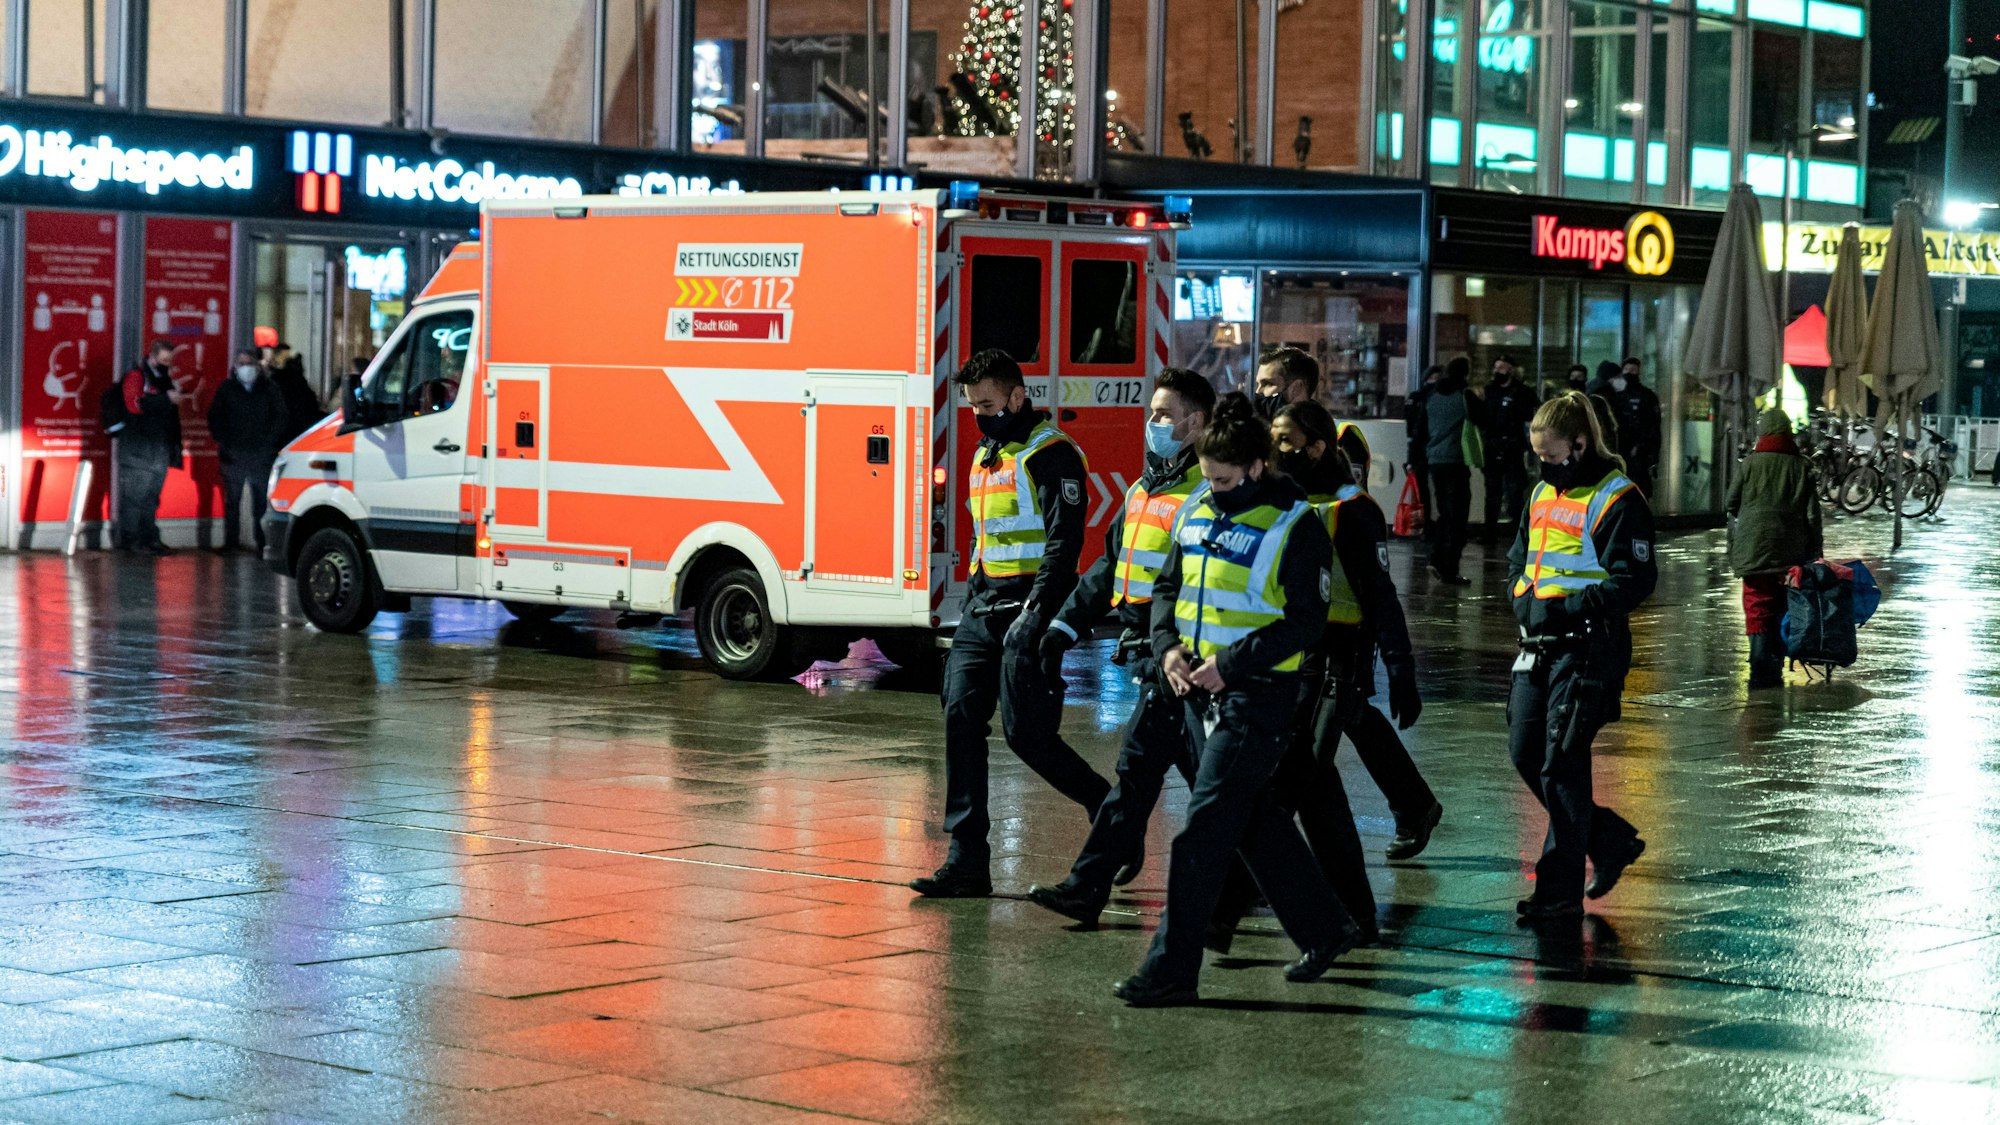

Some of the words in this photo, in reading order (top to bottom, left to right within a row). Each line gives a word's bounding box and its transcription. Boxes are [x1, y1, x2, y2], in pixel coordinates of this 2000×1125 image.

[25, 129, 254, 195] Highspeed
[366, 154, 583, 204] NetCologne
[1533, 214, 1625, 270] Kamps
[679, 252, 799, 268] RETTUNGSDIENST
[752, 277, 794, 308] 112
[694, 319, 717, 332] Stadt
[718, 319, 738, 332] Köln
[1114, 381, 1142, 404] 112
[519, 411, 530, 421] G1
[872, 425, 885, 435] G5
[553, 562, 564, 571] G3
